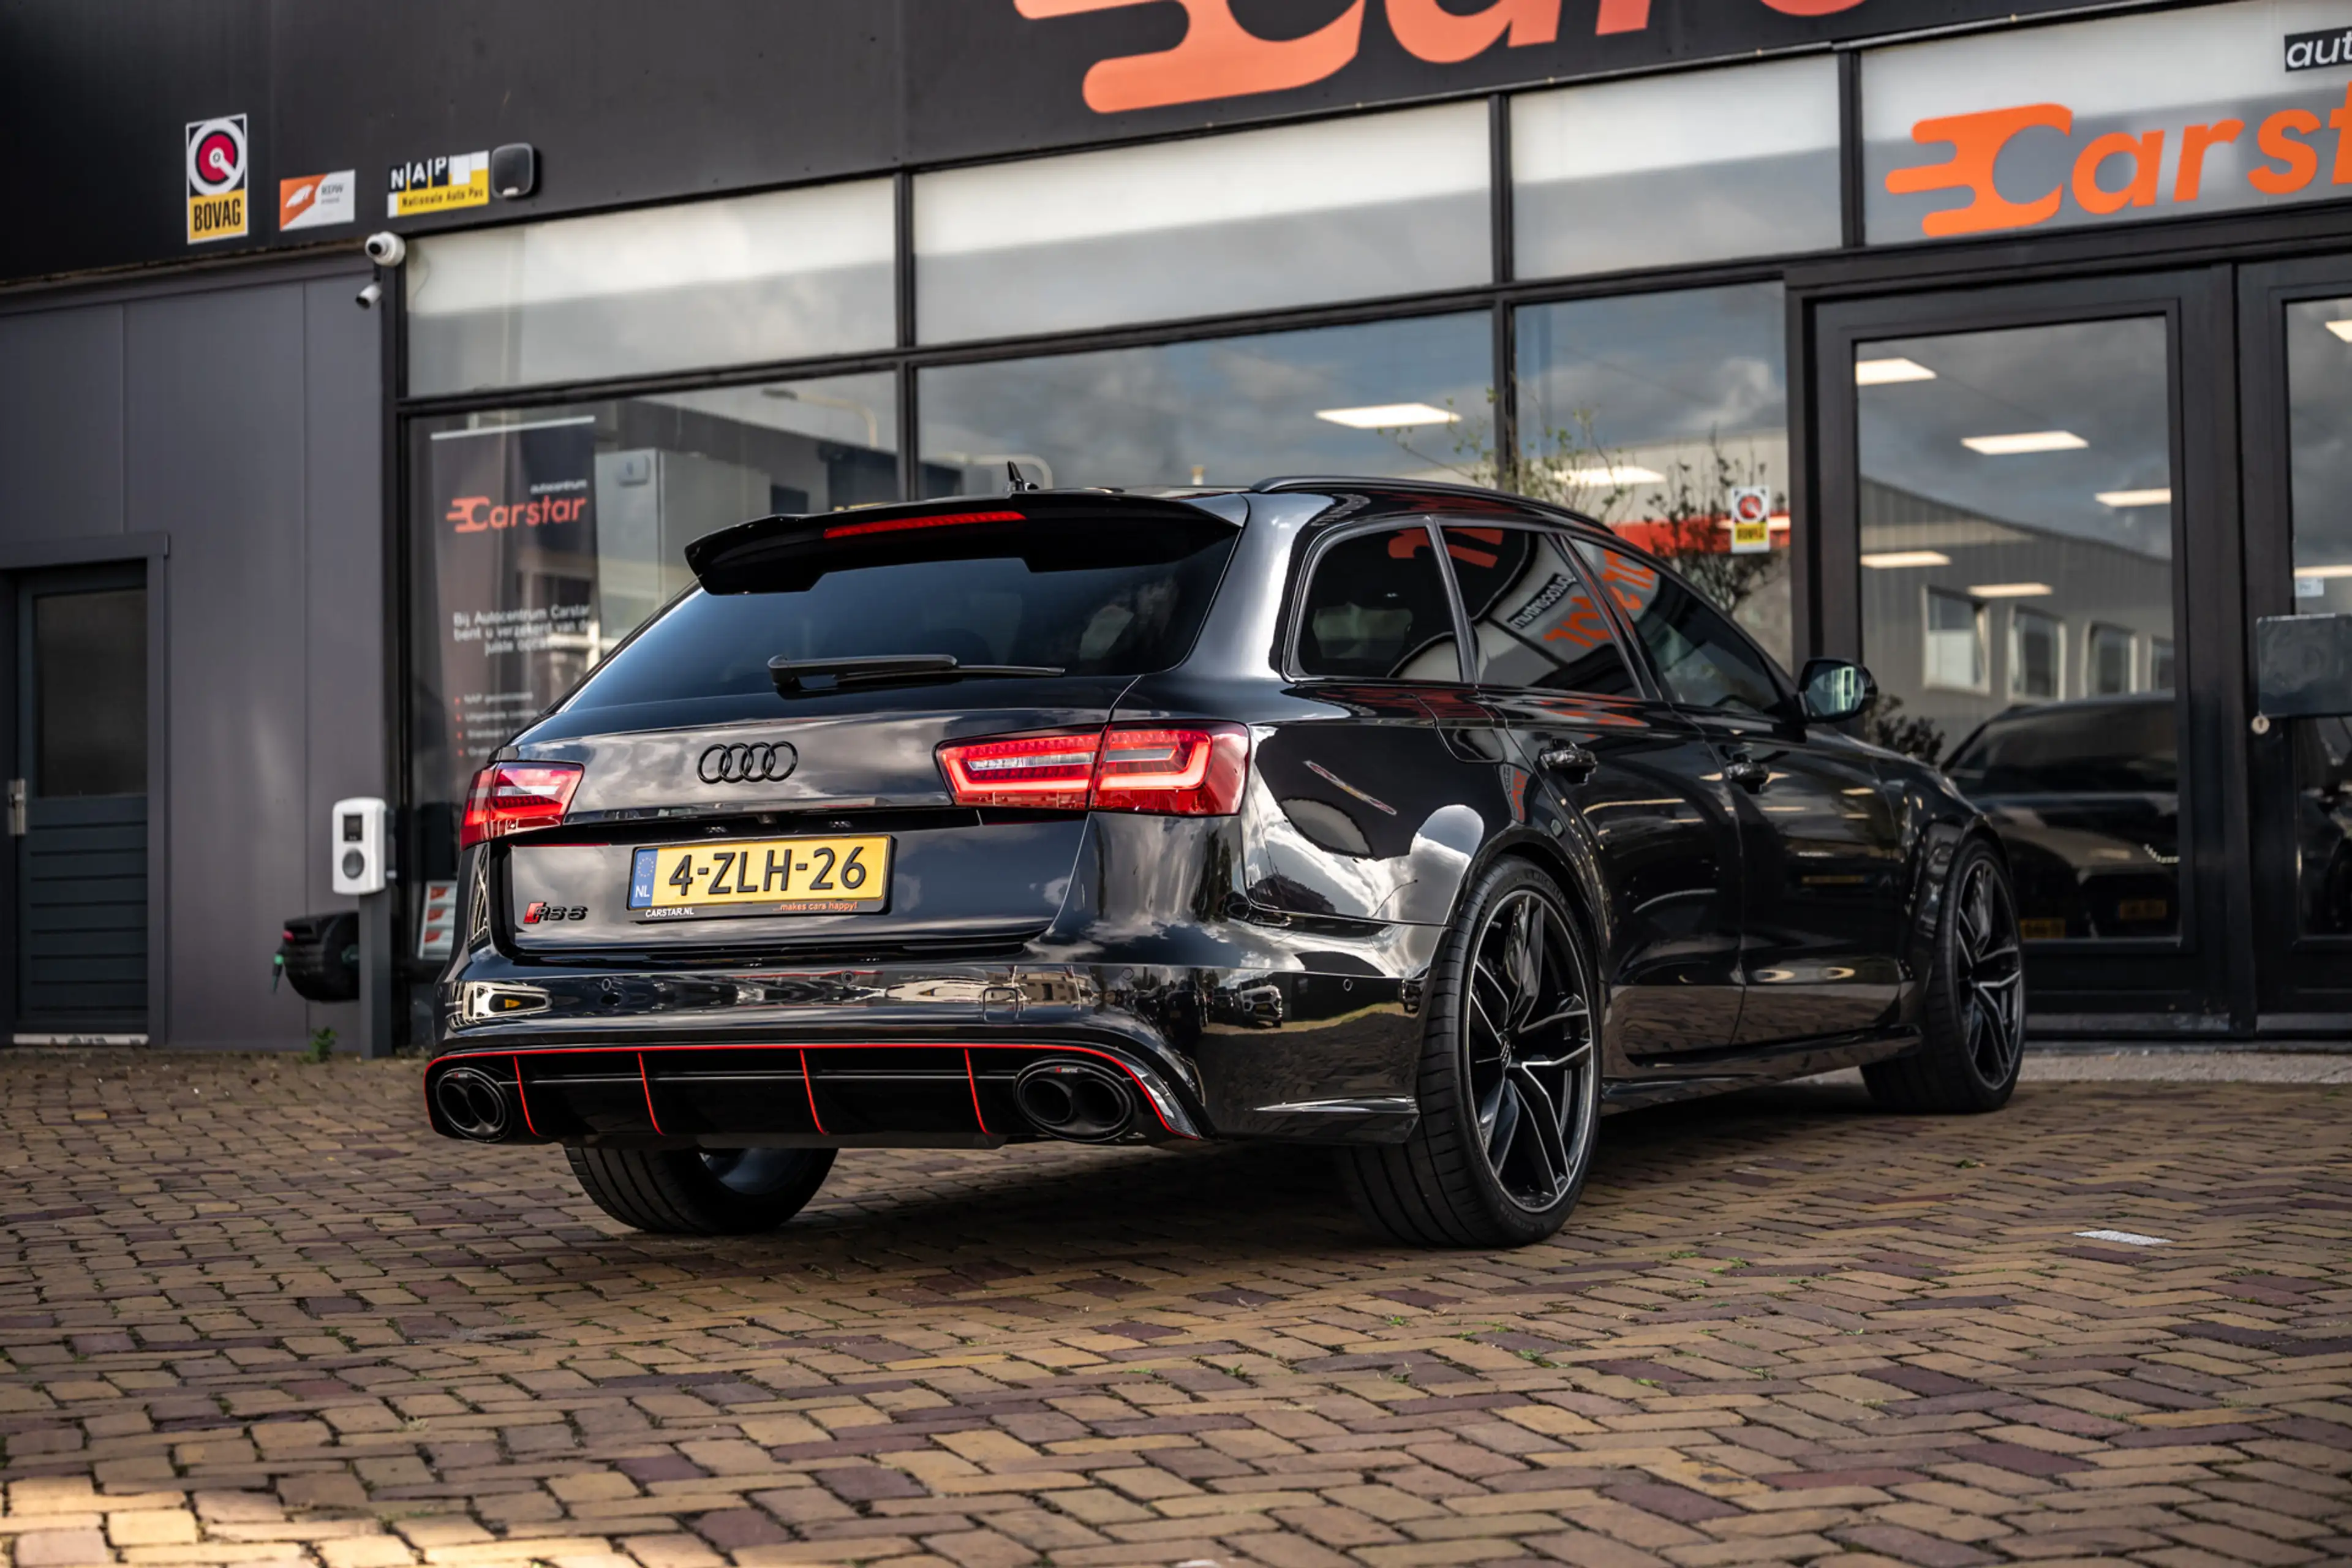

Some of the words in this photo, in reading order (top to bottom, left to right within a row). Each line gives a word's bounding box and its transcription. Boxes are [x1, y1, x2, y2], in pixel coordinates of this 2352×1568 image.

[402, 192, 443, 208] Nationale
[447, 190, 466, 202] Auto
[194, 197, 241, 232] BOVAG
[446, 495, 587, 533] Carstar
[453, 611, 470, 628] Bij
[474, 608, 548, 625] Autocentrum
[551, 602, 590, 620] Carstar
[453, 627, 481, 641] bent
[668, 846, 867, 896] 4-ZLH-26
[634, 885, 650, 898] NL
[645, 907, 694, 918] CARSTAR.NL
[829, 901, 858, 912] happy!
